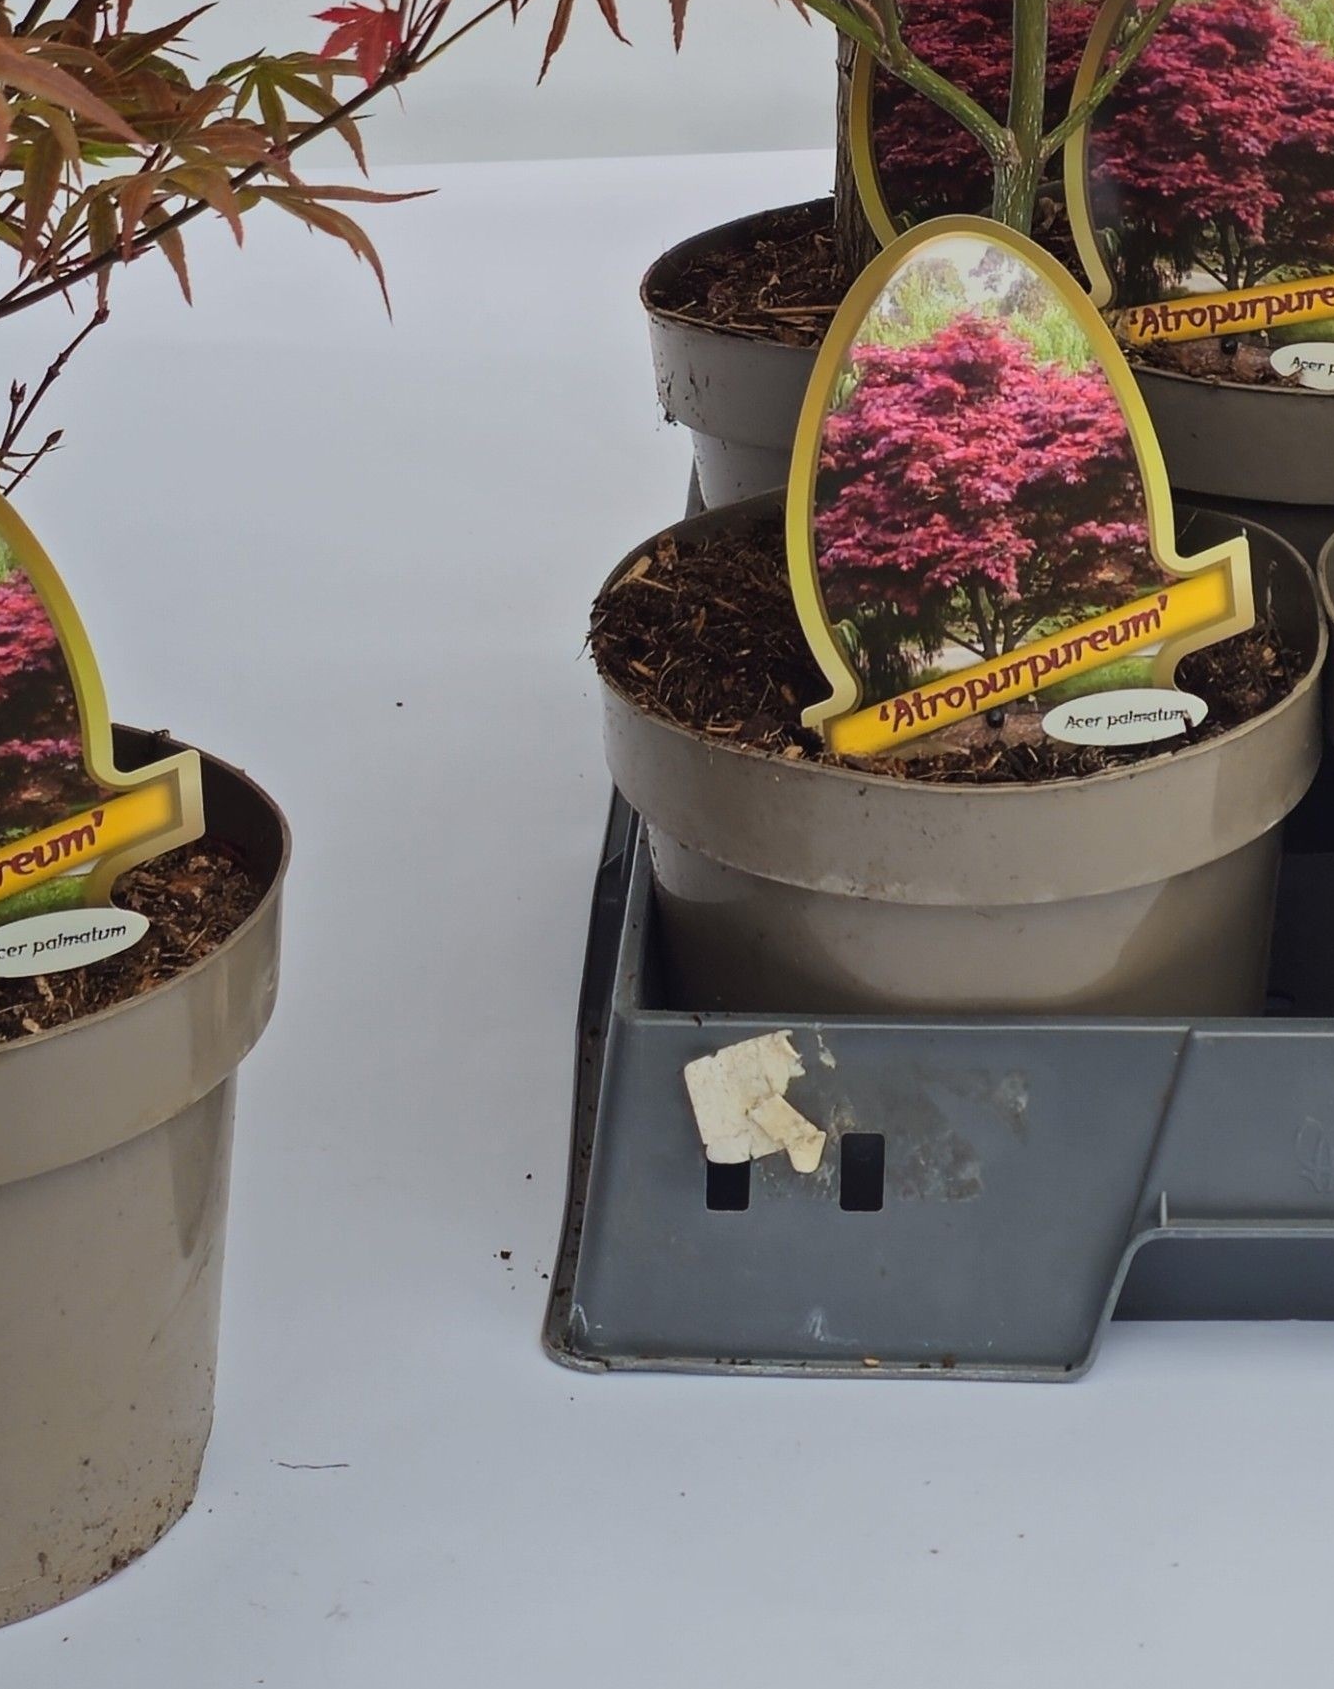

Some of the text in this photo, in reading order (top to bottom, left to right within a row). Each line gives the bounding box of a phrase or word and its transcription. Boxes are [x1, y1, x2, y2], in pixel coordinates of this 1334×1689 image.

[1291, 355, 1325, 371] Acer
[1065, 712, 1102, 730] Acer
[33, 923, 127, 954] palmatum
